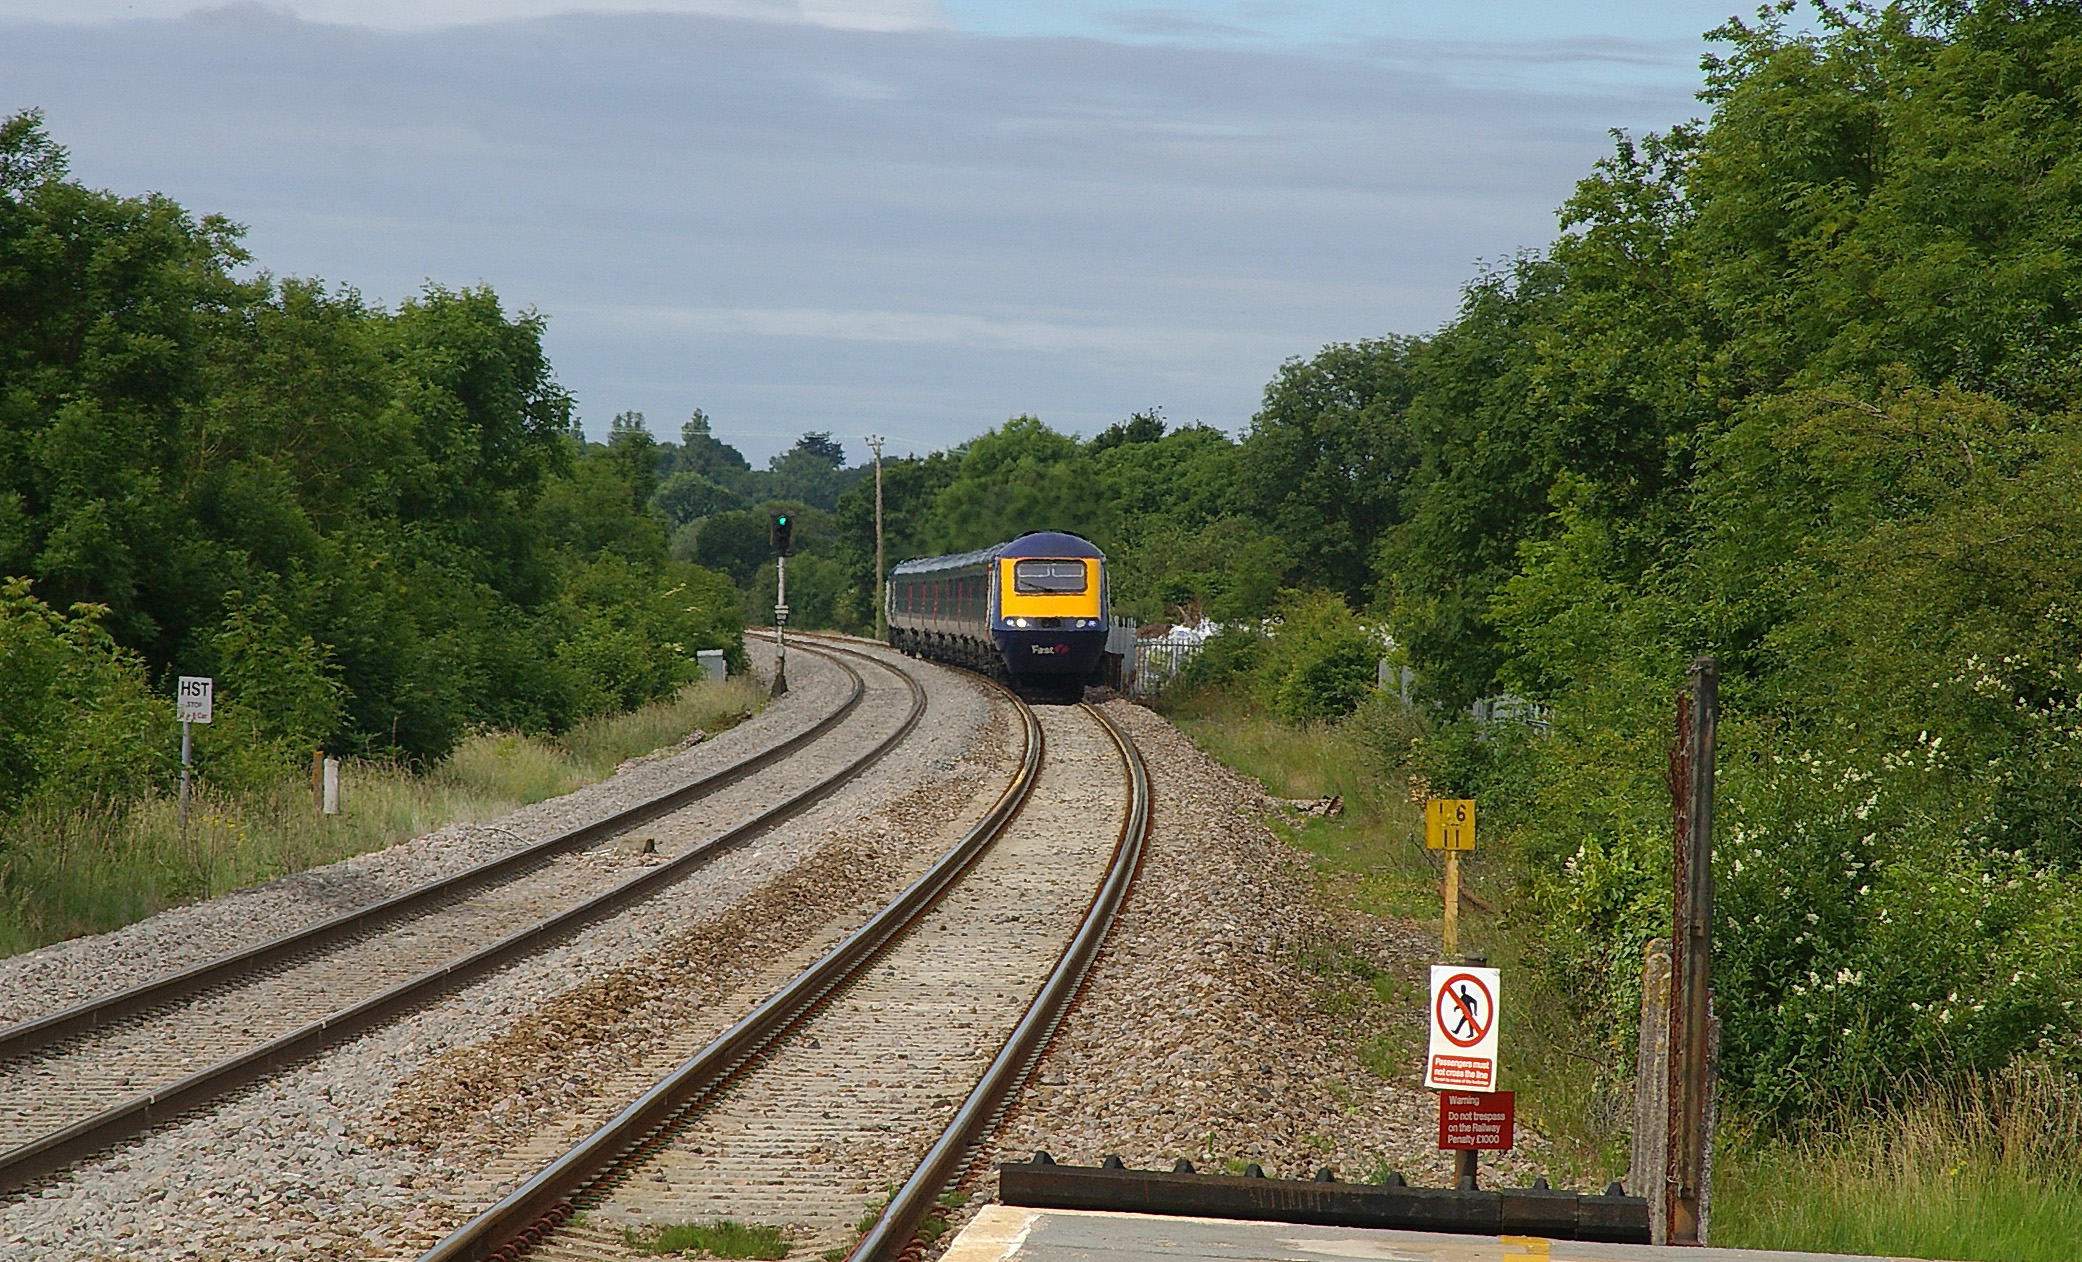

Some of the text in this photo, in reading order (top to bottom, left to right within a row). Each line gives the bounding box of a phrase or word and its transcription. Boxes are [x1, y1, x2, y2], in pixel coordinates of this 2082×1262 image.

[1031, 644, 1054, 655] First
[181, 681, 209, 697] HST
[186, 701, 202, 709] STOP
[1444, 829, 1460, 848] 11
[1435, 1057, 1490, 1070] Passengers must
[1434, 1068, 1489, 1079] not cross the line
[1449, 1095, 1479, 1106] Warning
[1448, 1111, 1506, 1122] Do not trespass
[1448, 1123, 1501, 1134] on the Railway
[1448, 1134, 1500, 1146] Penalty £1000
